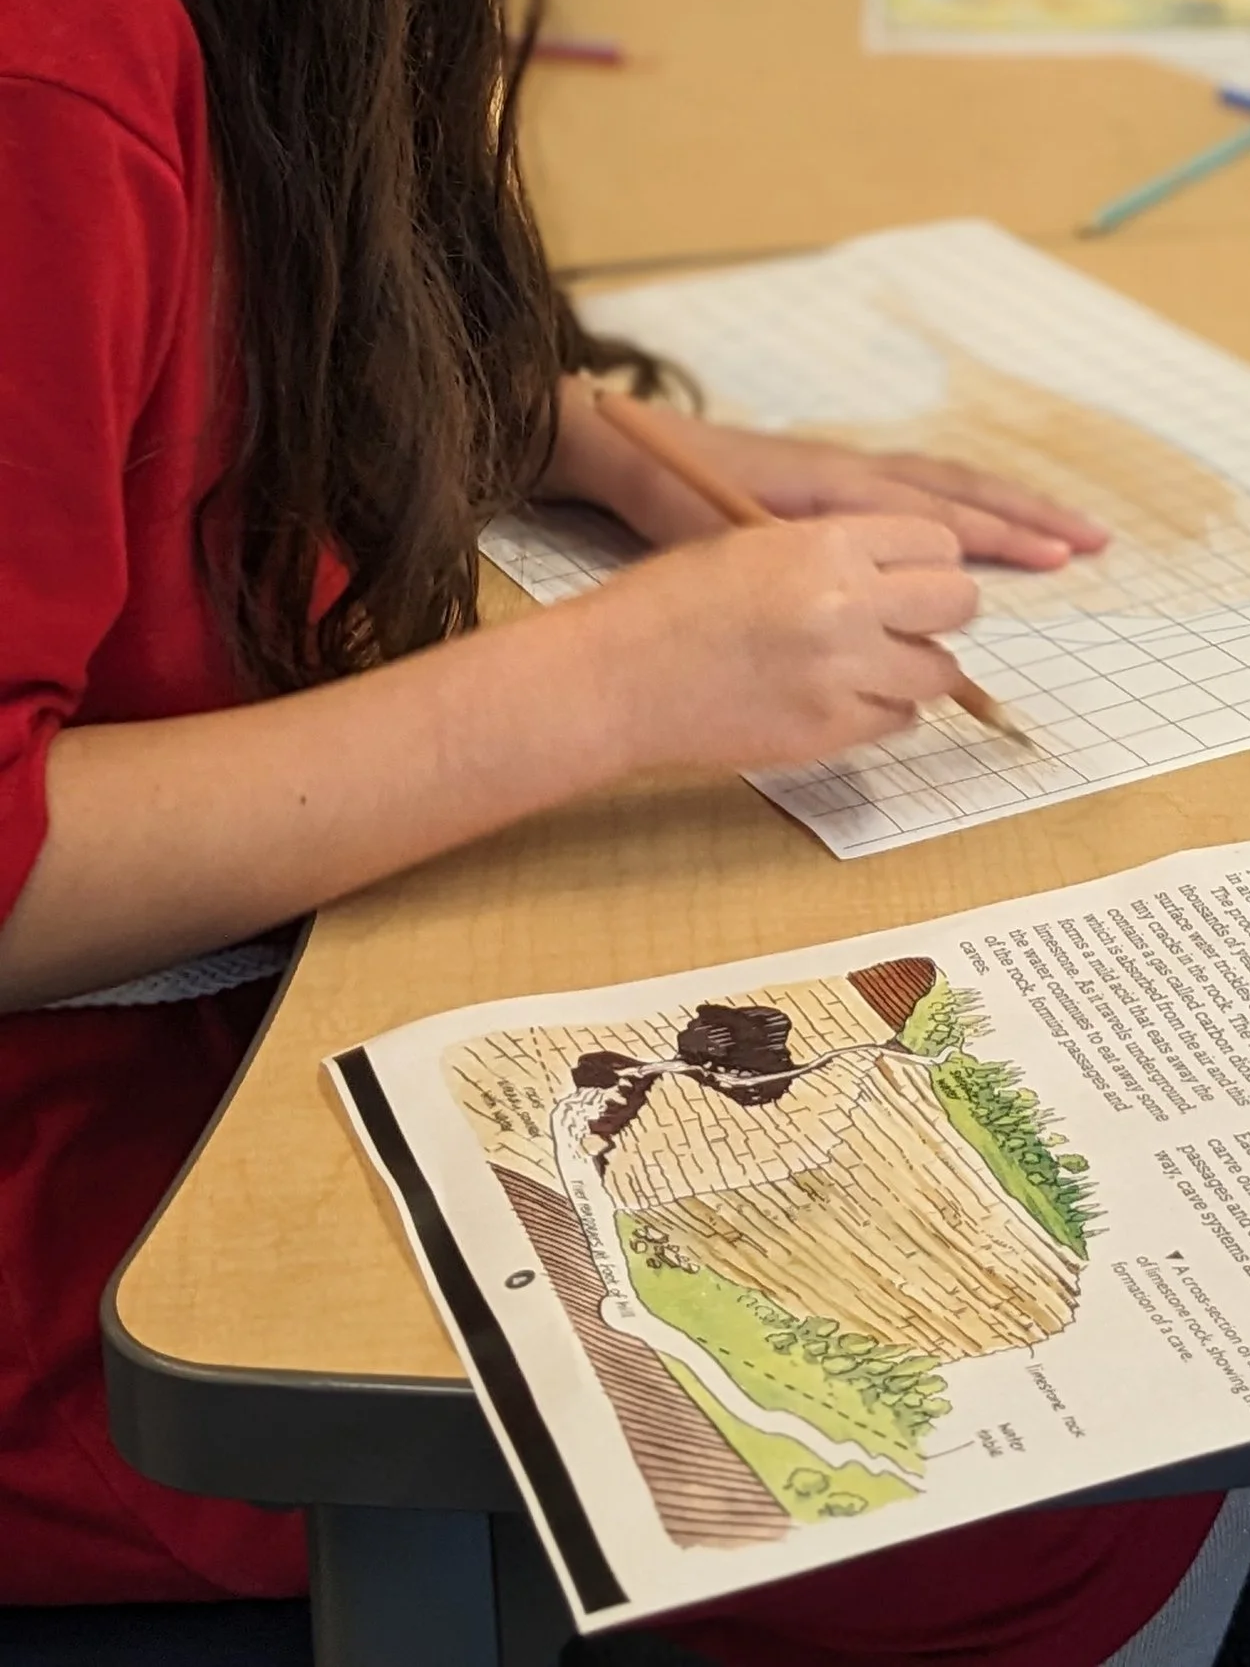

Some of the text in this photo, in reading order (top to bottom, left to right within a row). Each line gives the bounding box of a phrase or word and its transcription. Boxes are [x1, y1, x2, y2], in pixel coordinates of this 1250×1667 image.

[1177, 883, 1230, 938] thousands
[1223, 936, 1246, 949] of
[1209, 885, 1234, 907] The
[1106, 908, 1149, 950] contains
[959, 941, 990, 976] caves.
[1129, 899, 1155, 920] tiny
[1147, 920, 1184, 955] cracks
[1176, 952, 1194, 966] in
[1186, 964, 1209, 983] the
[1201, 983, 1234, 1014] rock.
[1141, 949, 1155, 959] a
[1145, 957, 1173, 976] gas
[1056, 918, 1215, 1102] forms a mild acid that eats away the
[1165, 975, 1206, 1012] called
[983, 935, 1134, 1112] of the rock, forming passages and
[1194, 1011, 1235, 1055] carbon
[1207, 1138, 1242, 1174] carve
[1153, 1149, 1183, 1179] way,
[1176, 1180, 1208, 1211] cave
[1200, 1211, 1250, 1263] systems
[600, 1263, 620, 1284] foot
[1135, 1255, 1158, 1268] of
[1110, 1261, 1193, 1363] formation of a cave.
[1145, 1266, 1191, 1318] limestone
[1171, 1266, 1190, 1276] A
[1181, 1276, 1243, 1345] cross-section
[1183, 1317, 1214, 1347] rock,
[1205, 1346, 1250, 1395] showing
[1026, 1363, 1086, 1438] limestone rock
[998, 1422, 1026, 1452] water
